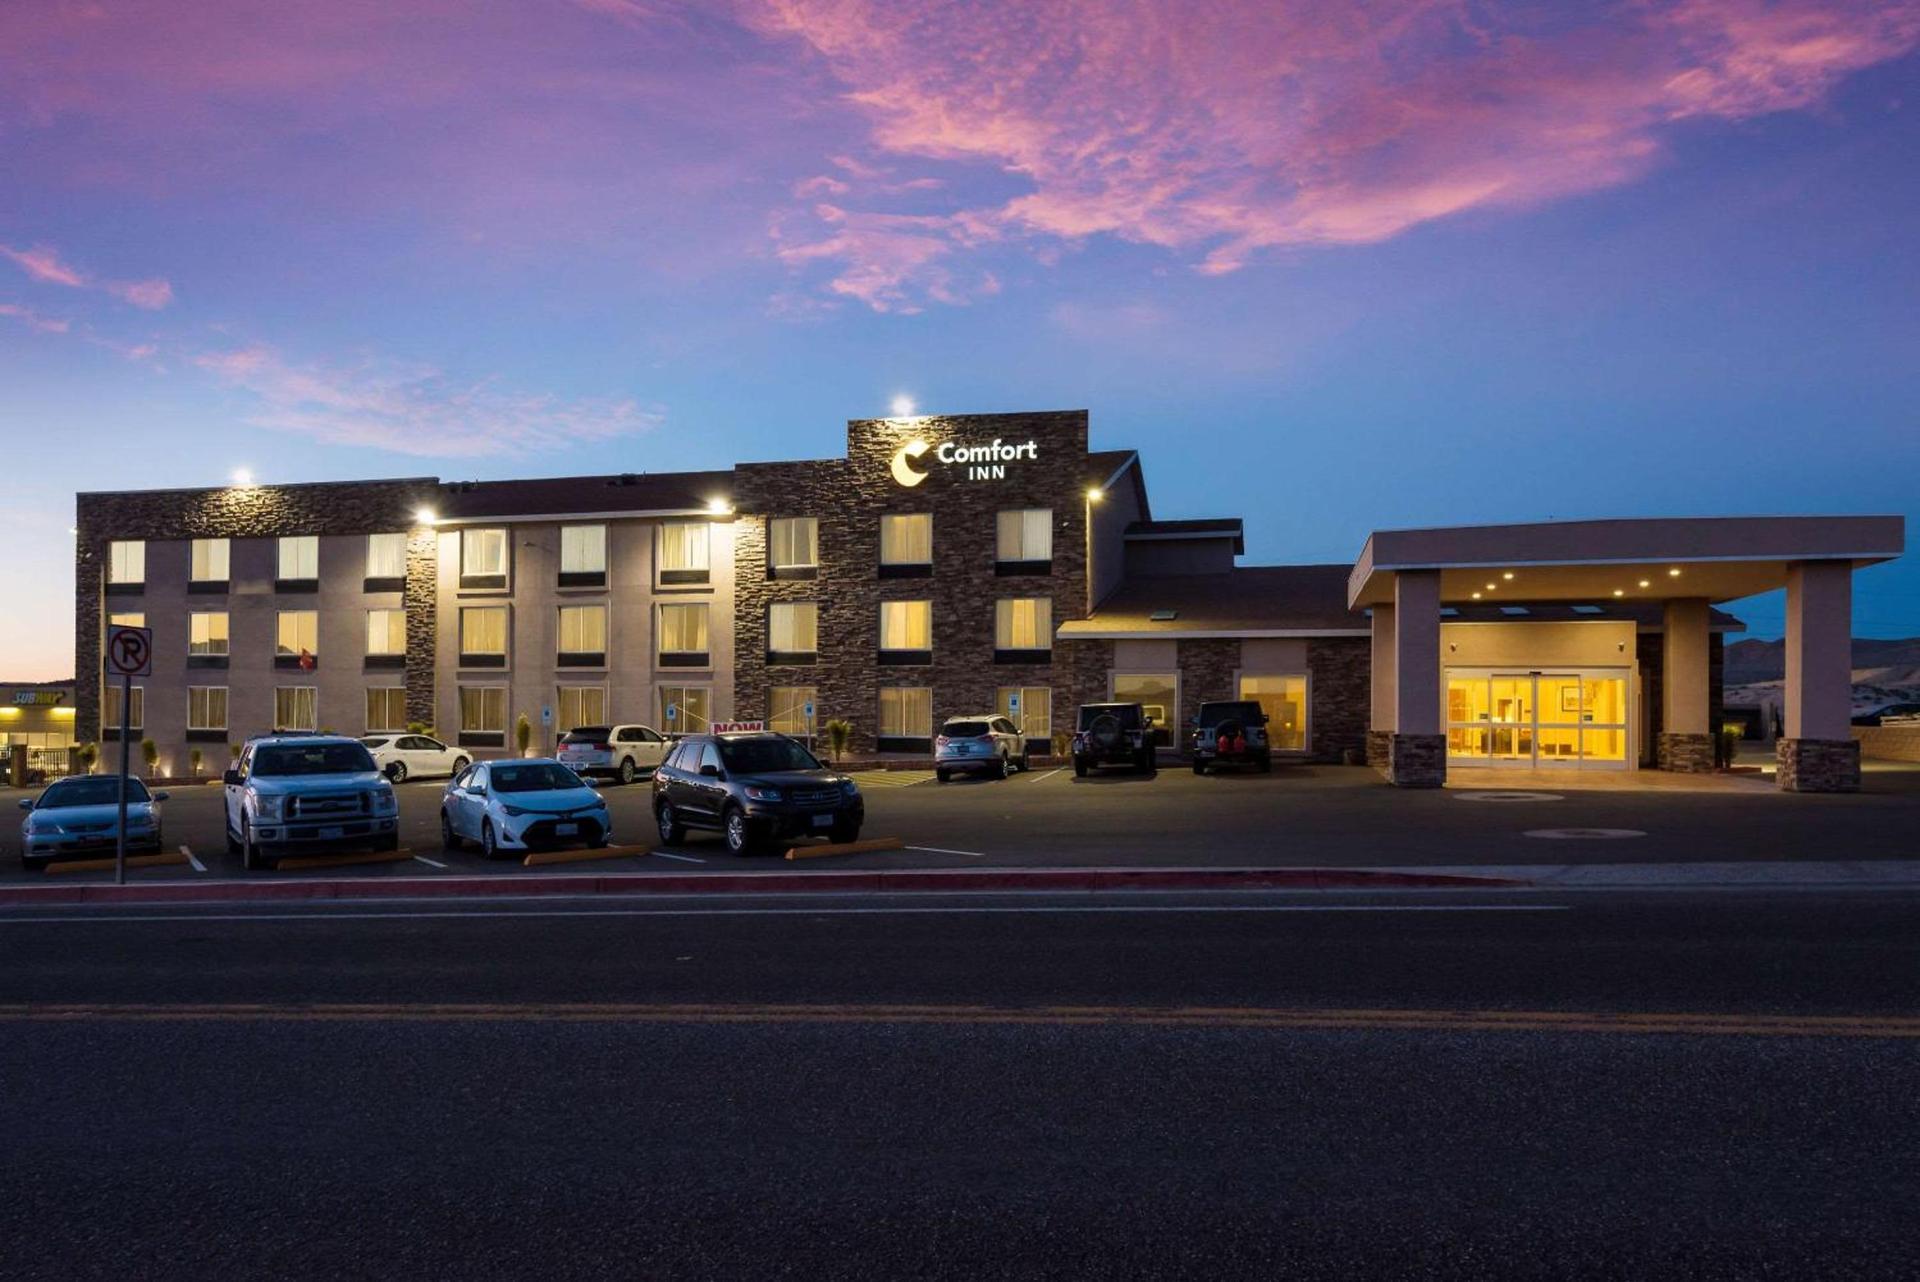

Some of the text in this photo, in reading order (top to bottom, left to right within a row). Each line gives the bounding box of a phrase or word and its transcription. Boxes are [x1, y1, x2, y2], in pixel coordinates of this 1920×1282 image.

[937, 439, 1037, 463] Comfort
[969, 465, 1005, 481] INN
[13, 691, 65, 704] SUBWAY
